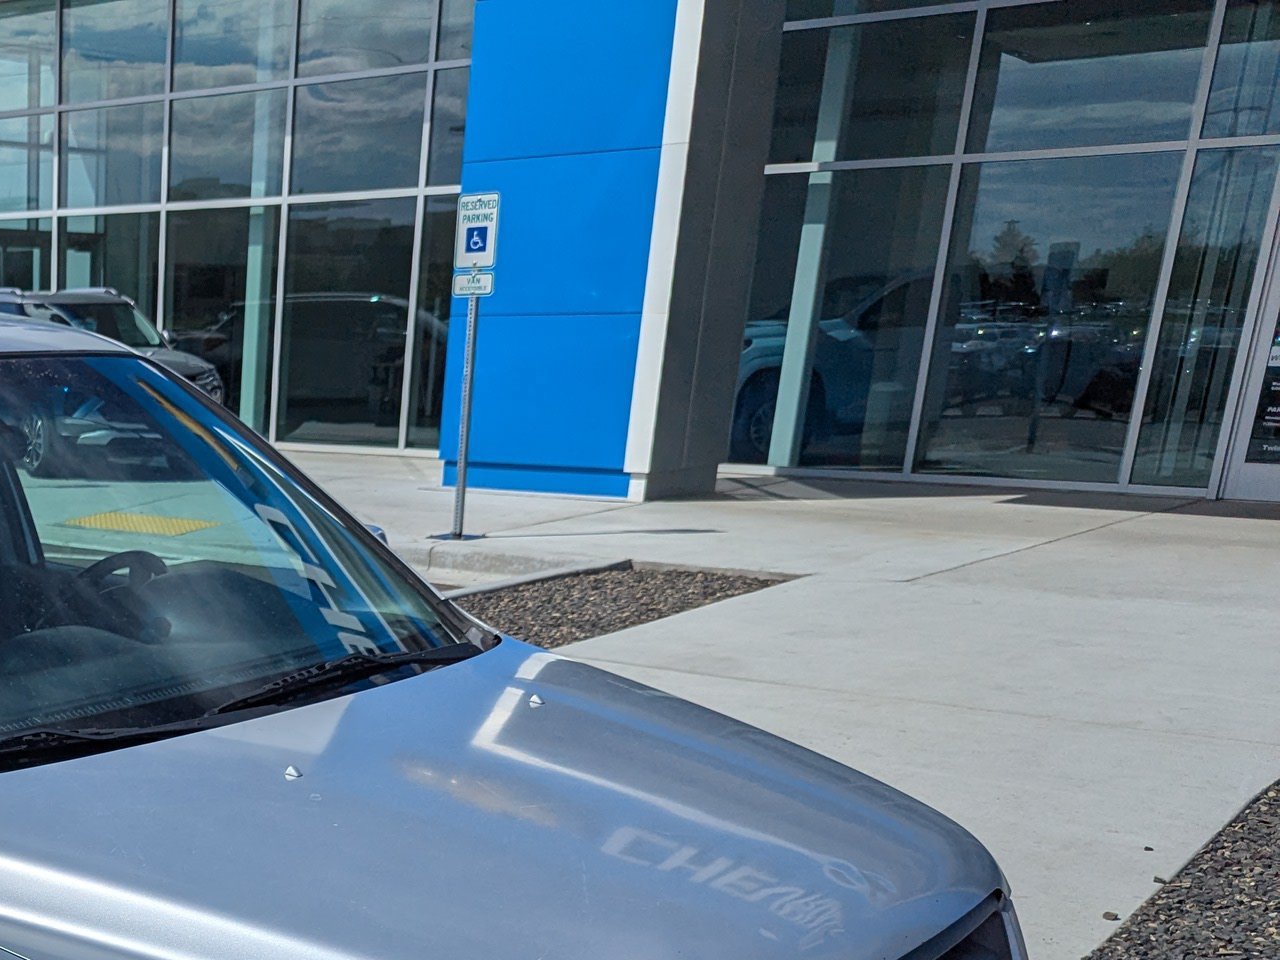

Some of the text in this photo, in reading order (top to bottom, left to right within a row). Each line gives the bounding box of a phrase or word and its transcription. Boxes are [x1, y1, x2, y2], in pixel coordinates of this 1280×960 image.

[460, 199, 497, 211] RESERVED
[462, 212, 494, 224] PARKING
[466, 277, 481, 285] VAN
